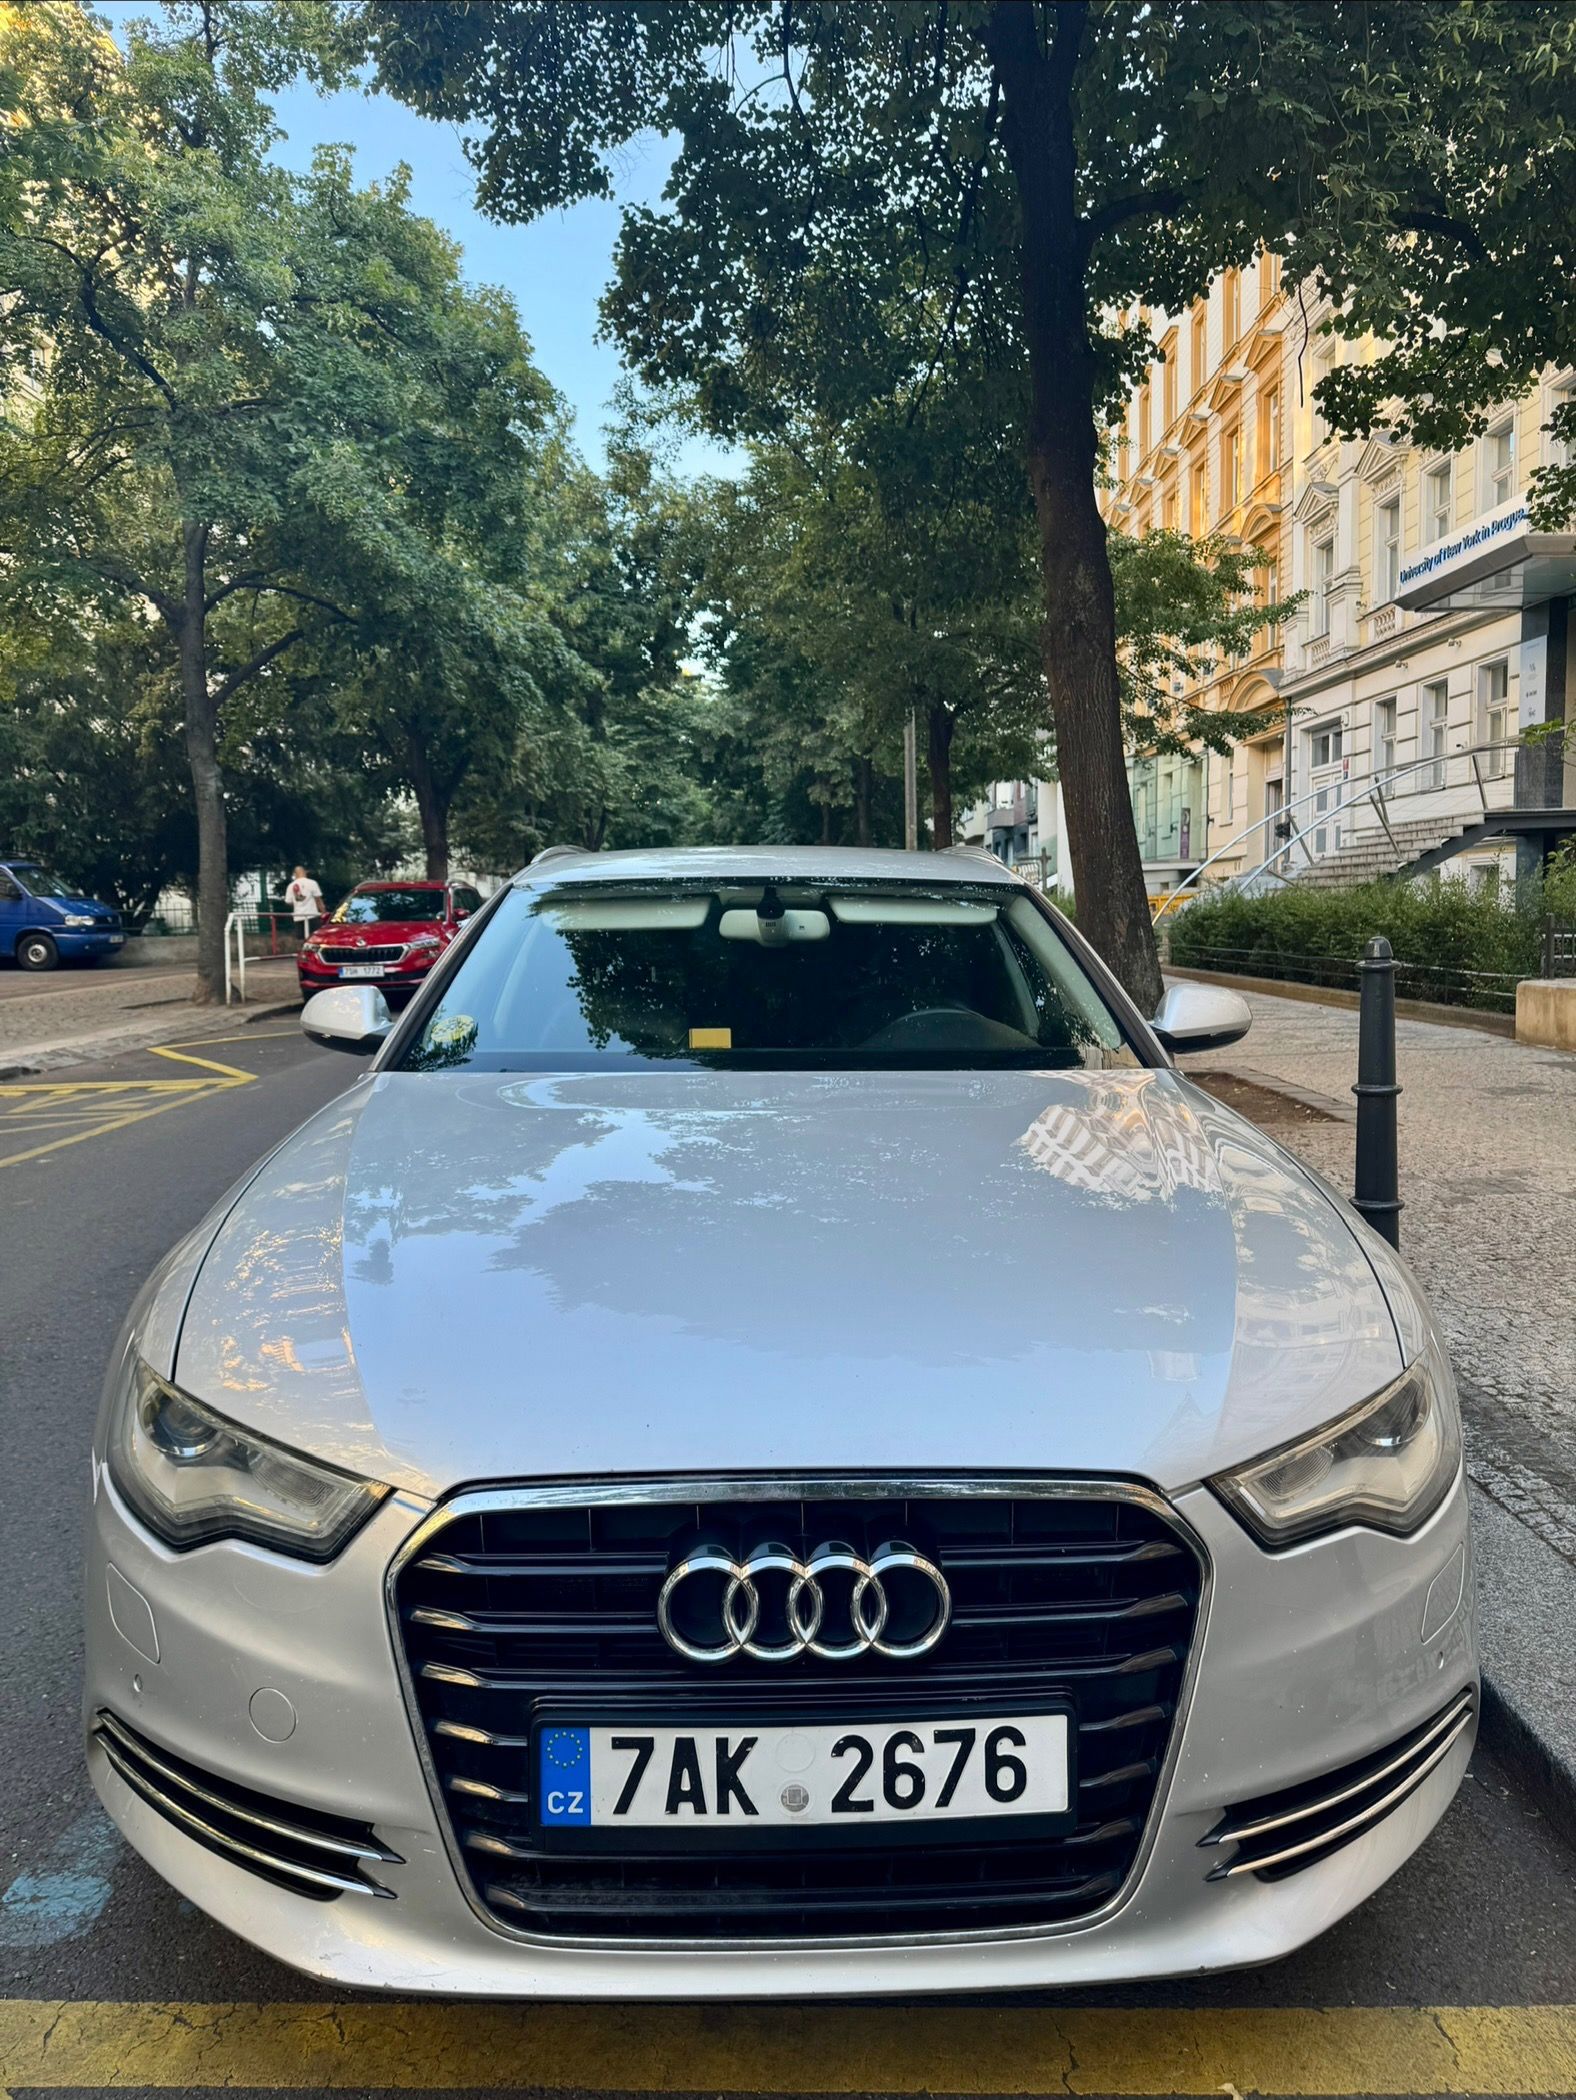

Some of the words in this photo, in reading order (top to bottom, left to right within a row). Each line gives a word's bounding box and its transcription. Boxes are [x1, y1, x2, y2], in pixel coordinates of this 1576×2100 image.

[1400, 557, 1434, 584] University
[1433, 548, 1443, 565] of
[1443, 541, 1462, 560] New
[1462, 530, 1481, 550] York
[1481, 525, 1491, 542] in
[1491, 508, 1525, 535] Prague
[547, 1790, 584, 1815] CZ
[611, 1736, 759, 1816] 7AK
[831, 1725, 1028, 1813] 2676
